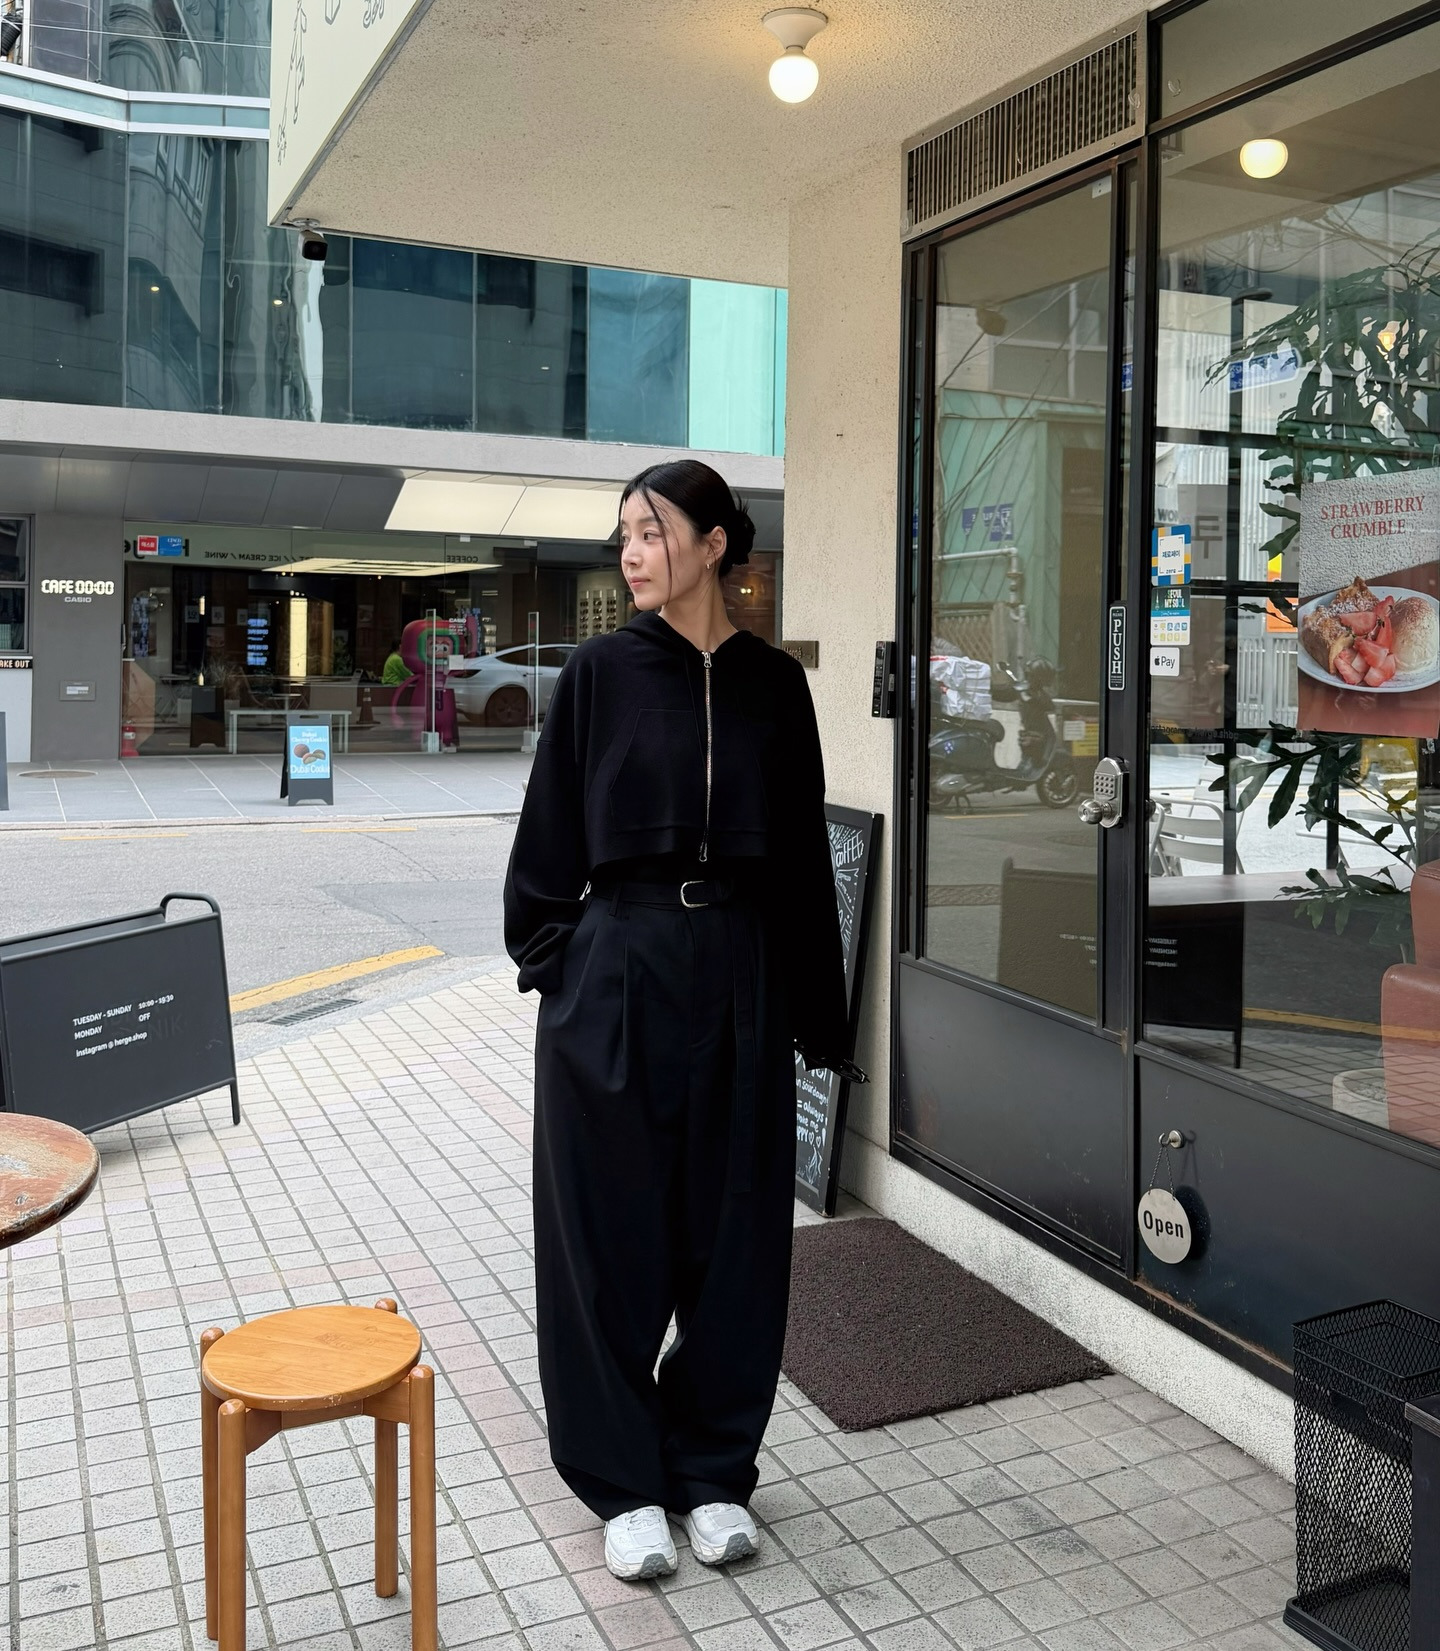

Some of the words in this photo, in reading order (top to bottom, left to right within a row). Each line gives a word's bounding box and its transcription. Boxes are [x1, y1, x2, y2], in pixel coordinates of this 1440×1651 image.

[1321, 496, 1425, 520] STRAWBERRY
[1330, 519, 1406, 539] CRUMBLE
[41, 579, 74, 594] CAFE
[75, 580, 115, 595] 00:00
[1112, 618, 1123, 674] PUSH
[0, 660, 13, 668] AKE
[14, 659, 30, 668] OUT
[1160, 656, 1176, 669] Pay
[73, 1012, 103, 1026] TUESDAY
[106, 1004, 133, 1018] SUNDAY
[138, 999, 155, 1010] 10:00
[74, 1025, 103, 1040] MONDAY
[138, 1012, 151, 1022] OFF
[1143, 1209, 1184, 1239] Open
